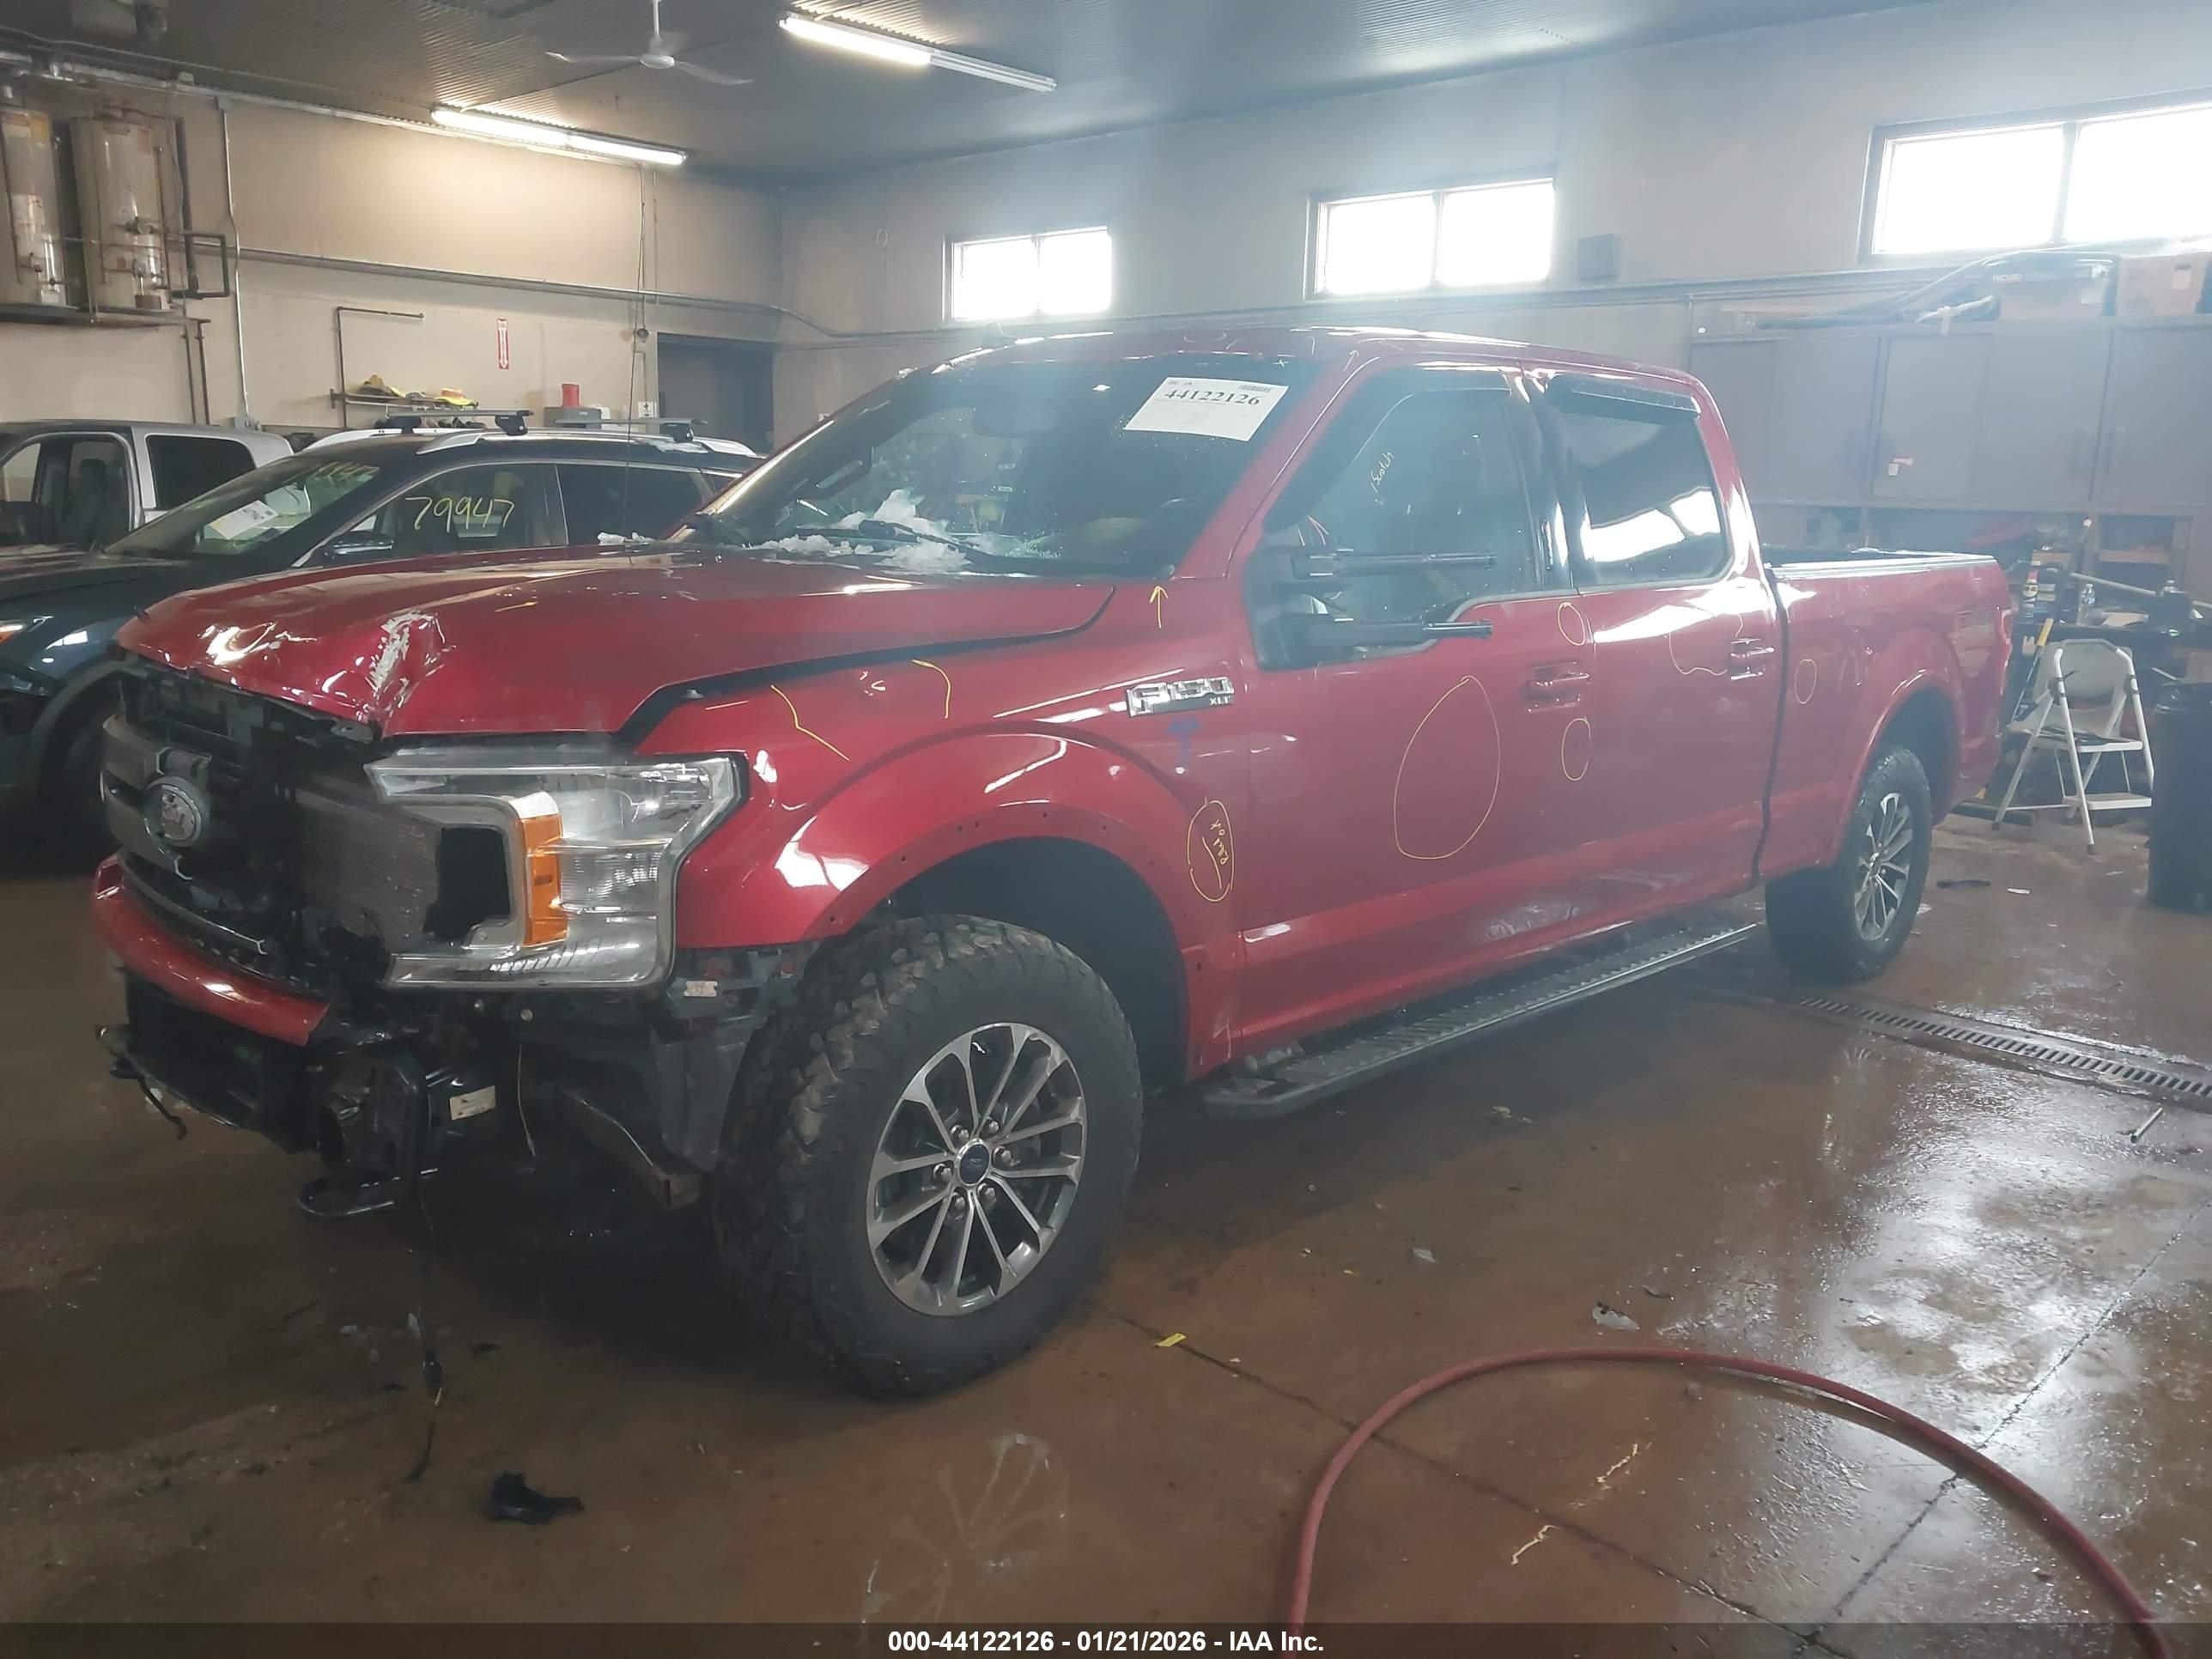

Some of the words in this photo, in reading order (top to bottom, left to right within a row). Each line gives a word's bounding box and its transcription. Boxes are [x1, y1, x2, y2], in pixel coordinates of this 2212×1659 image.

[1164, 387, 1261, 406] 44122126
[404, 495, 515, 533] 79947
[1209, 696, 1231, 707] XLT
